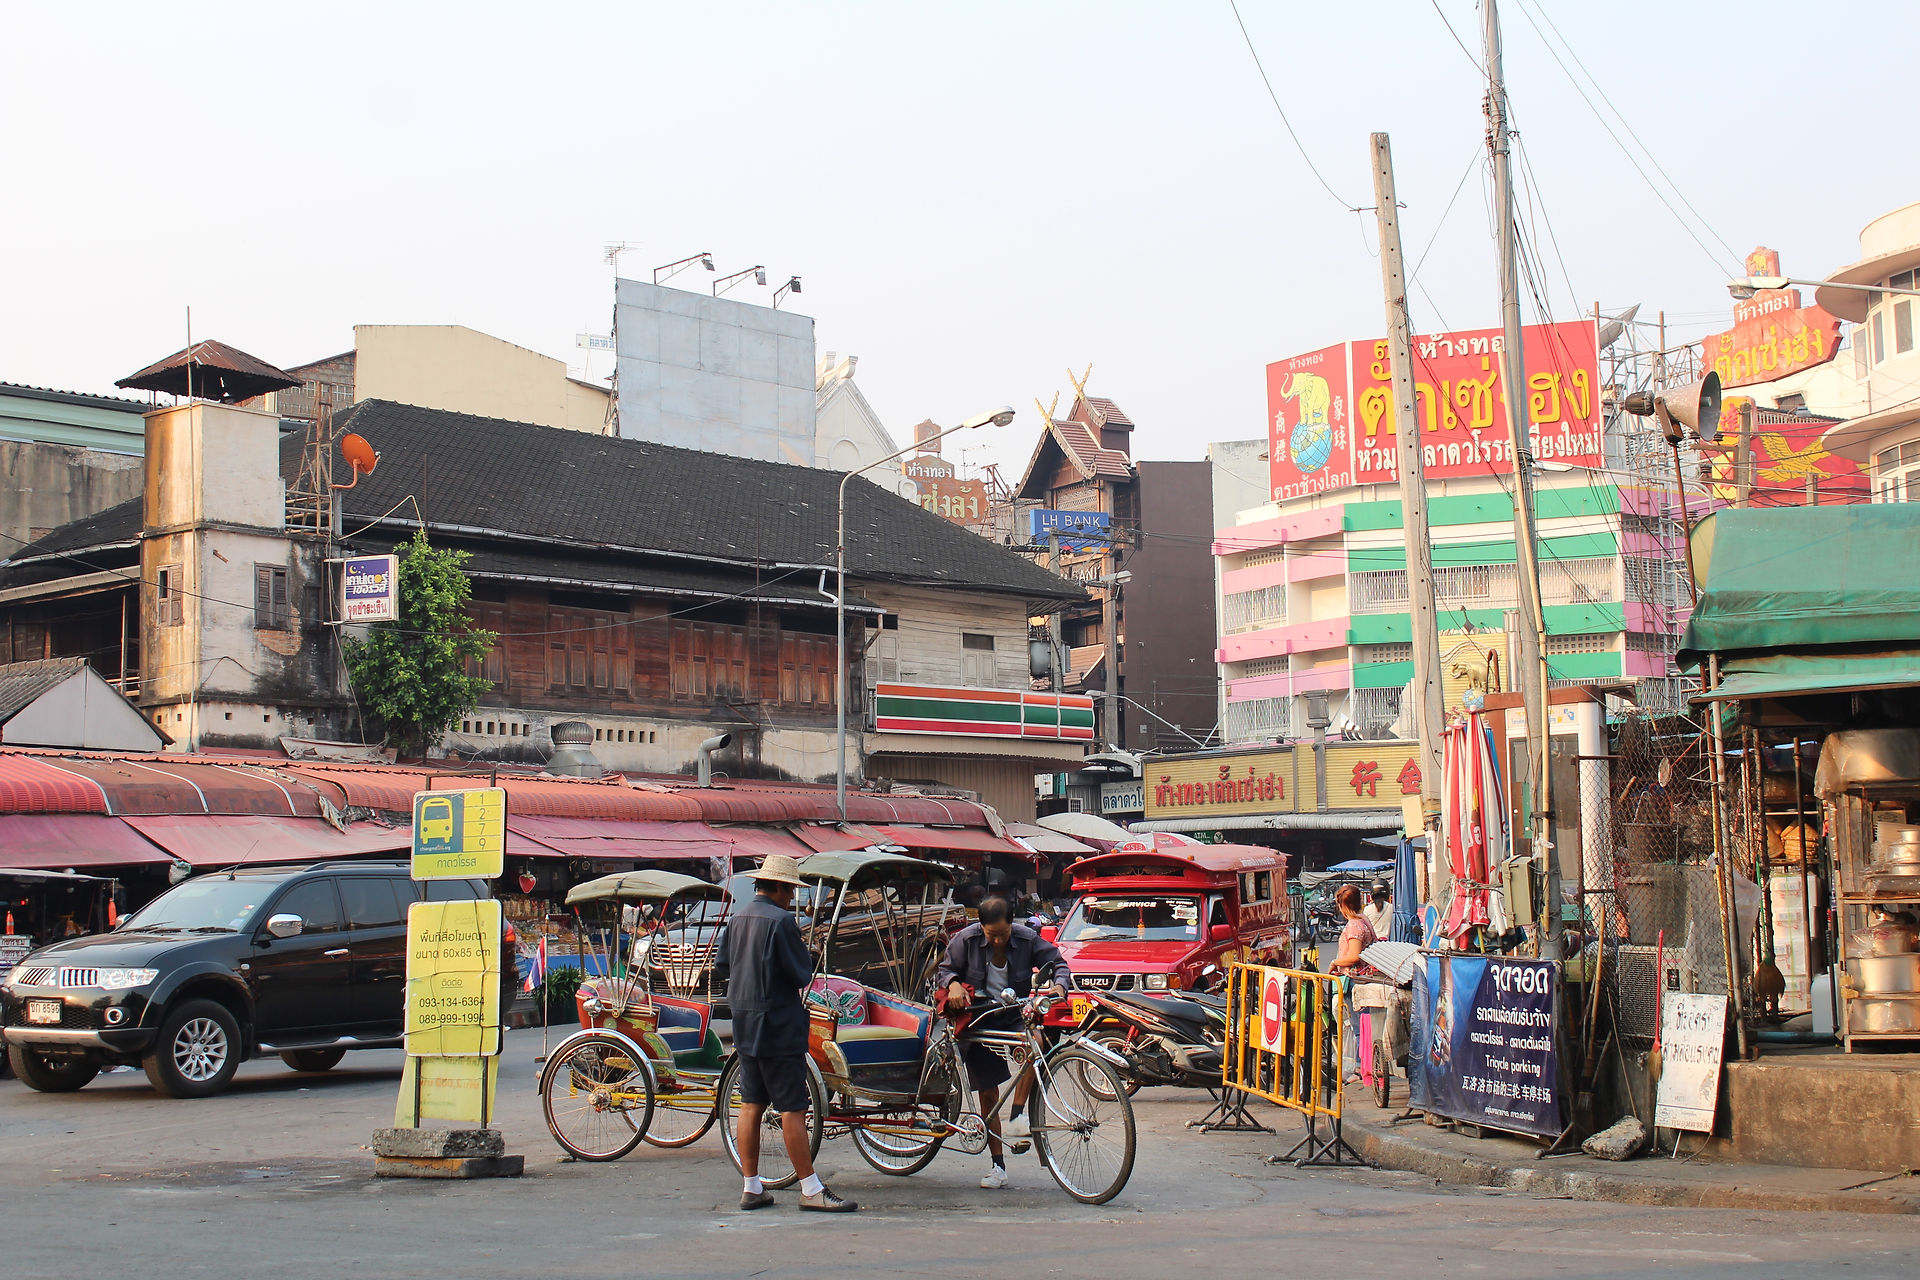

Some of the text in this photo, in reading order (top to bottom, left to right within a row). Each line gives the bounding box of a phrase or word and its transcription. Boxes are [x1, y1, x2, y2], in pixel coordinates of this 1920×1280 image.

[1738, 295, 1790, 323] ห้างทอง
[1418, 334, 1506, 360] ห้างทอ
[1289, 353, 1324, 371] ห้างทอง
[1358, 339, 1592, 437] ตั๊กเซ่ฮง
[907, 462, 953, 478] ห้างทอง
[1274, 466, 1349, 501] ตราช้างโลก
[1042, 514, 1101, 528] LH BANK
[479, 793, 484, 804] 1
[1102, 786, 1145, 809] ตลาดวโ
[479, 808, 486, 820] 2
[479, 823, 486, 835] 7
[478, 837, 487, 851] 9
[436, 854, 477, 868] กาดวโรรส
[420, 929, 487, 943] พื้นที่สื่อโฆษณา
[415, 947, 491, 960] ขนาด 60x85 cm
[1490, 964, 1549, 1001] จุดจอด
[419, 996, 485, 1008] 093-134-6364
[418, 1013, 485, 1024] 089-999-1994
[1485, 1054, 1541, 1078] Tricycle parking
